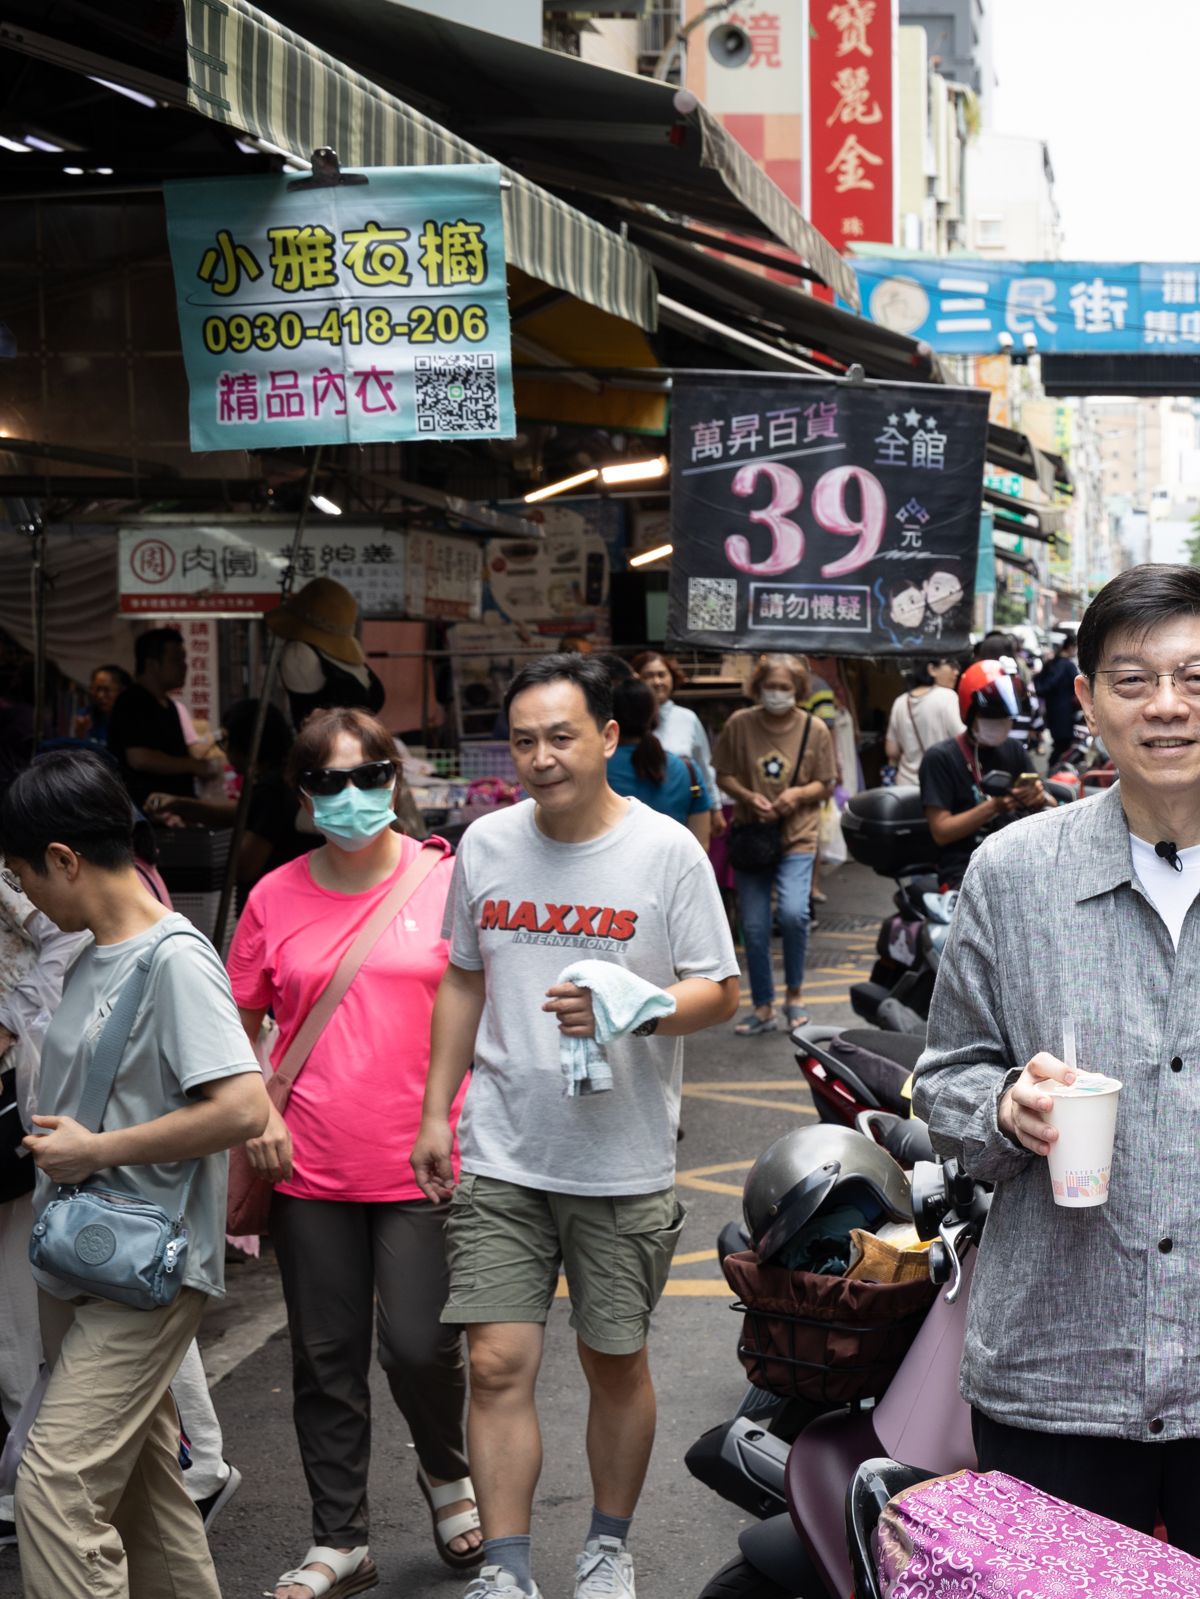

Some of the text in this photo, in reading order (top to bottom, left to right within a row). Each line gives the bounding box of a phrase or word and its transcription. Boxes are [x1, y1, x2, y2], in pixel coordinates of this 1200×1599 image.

[826, 0, 884, 193] 寶麗金
[197, 220, 488, 298] 小雅衣櫥
[203, 304, 488, 355] 0930-418-206
[936, 276, 1129, 335] 三民街
[690, 401, 840, 463] 萬昇百貨
[874, 426, 947, 471] 全館
[724, 462, 888, 579] 39
[901, 524, 922, 548] 元
[759, 592, 862, 622] 請勿懷疑
[481, 899, 638, 941] MAXXIS
[512, 932, 628, 953] INTERNATIONAL
